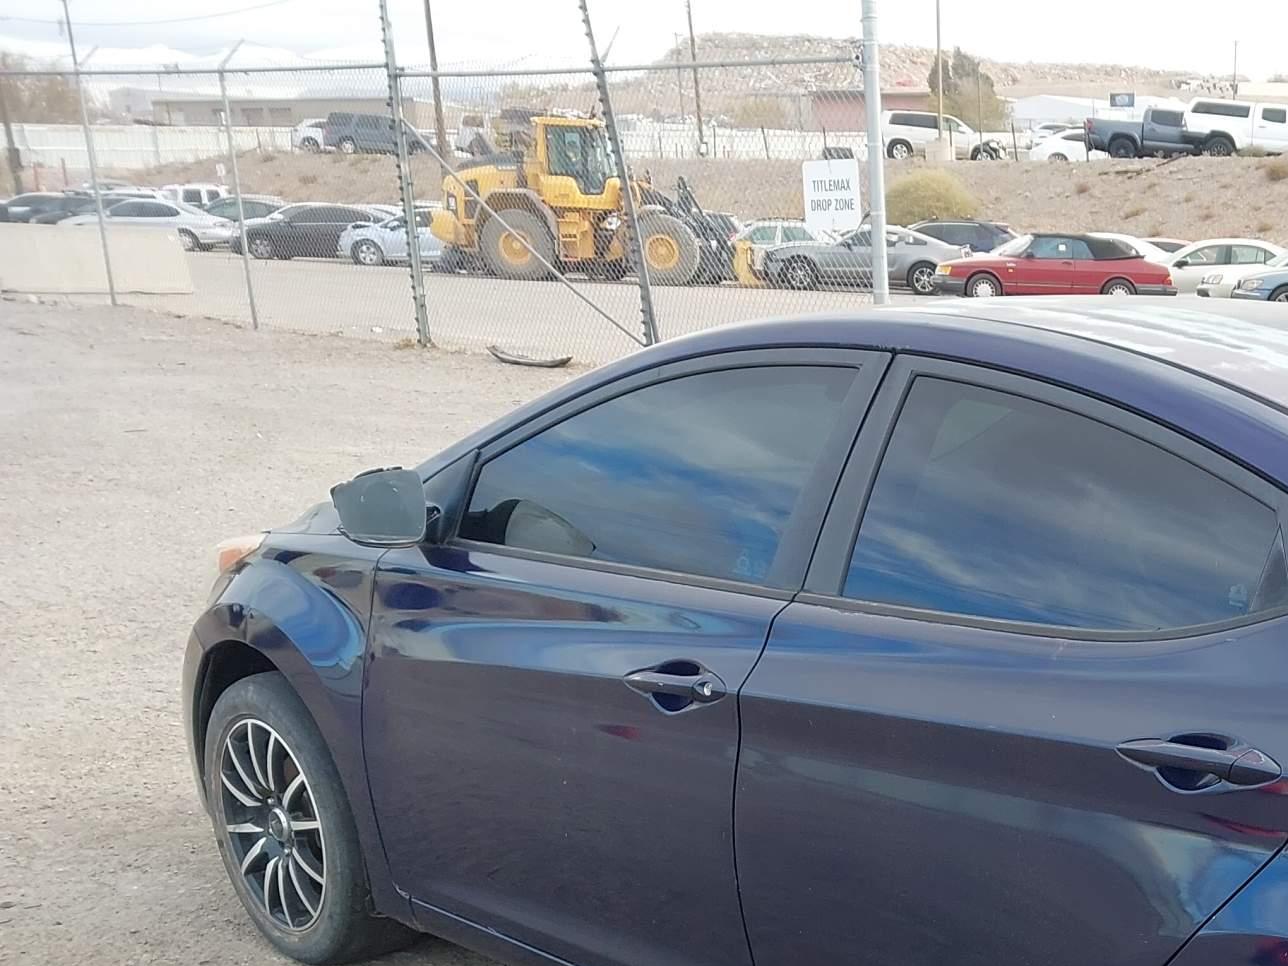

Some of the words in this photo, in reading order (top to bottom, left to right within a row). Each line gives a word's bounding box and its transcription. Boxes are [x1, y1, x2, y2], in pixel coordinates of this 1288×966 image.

[812, 178, 851, 192] TITLEMAX
[810, 198, 832, 211] DROP
[834, 198, 855, 211] ZONE
